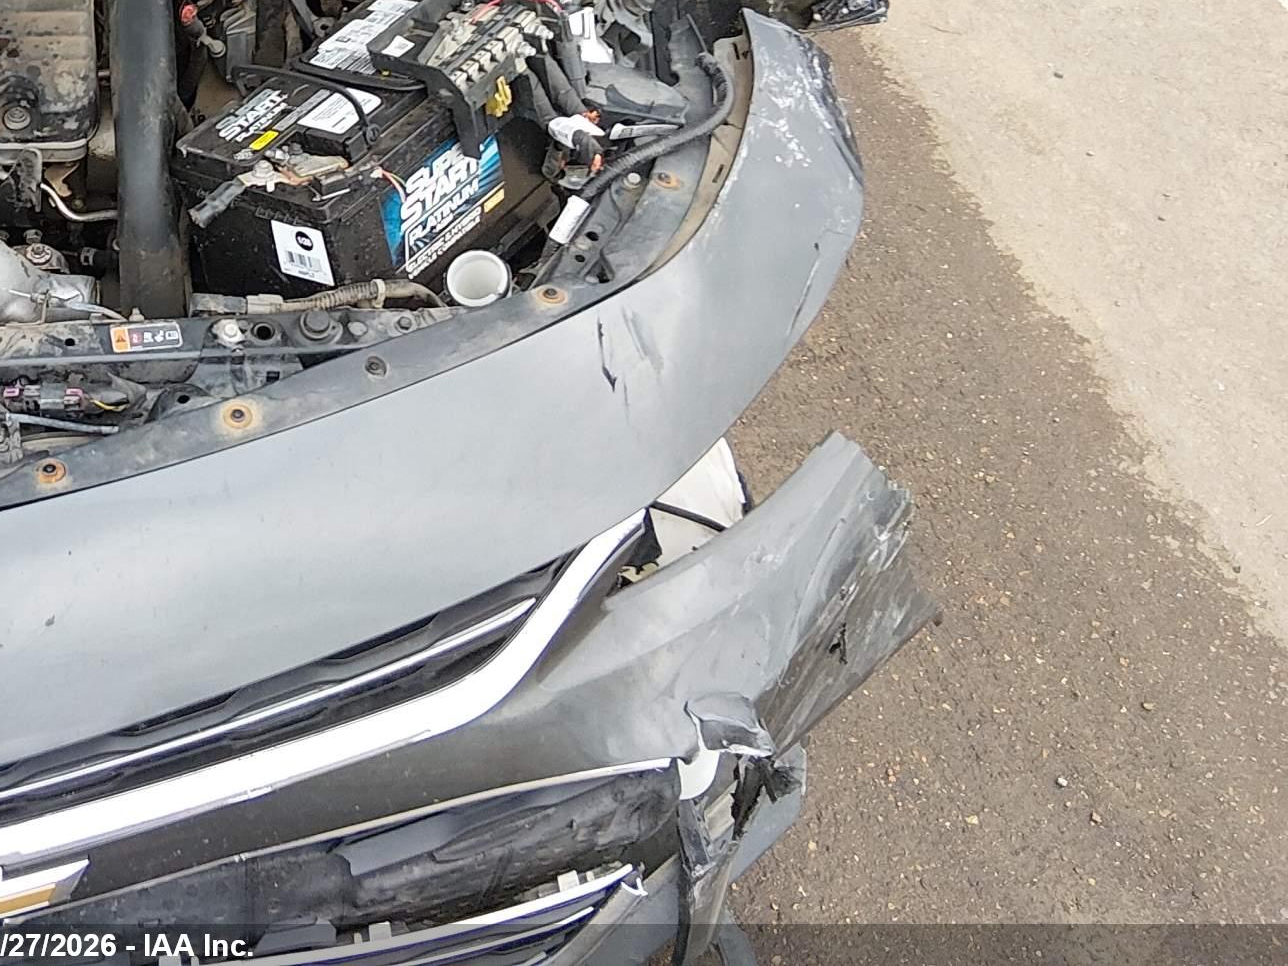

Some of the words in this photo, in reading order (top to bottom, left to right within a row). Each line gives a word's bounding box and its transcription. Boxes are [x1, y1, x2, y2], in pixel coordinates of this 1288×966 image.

[219, 90, 284, 141] START
[401, 156, 479, 232] START
[406, 142, 464, 193] SUPE
[409, 178, 479, 247] PLATINUM
